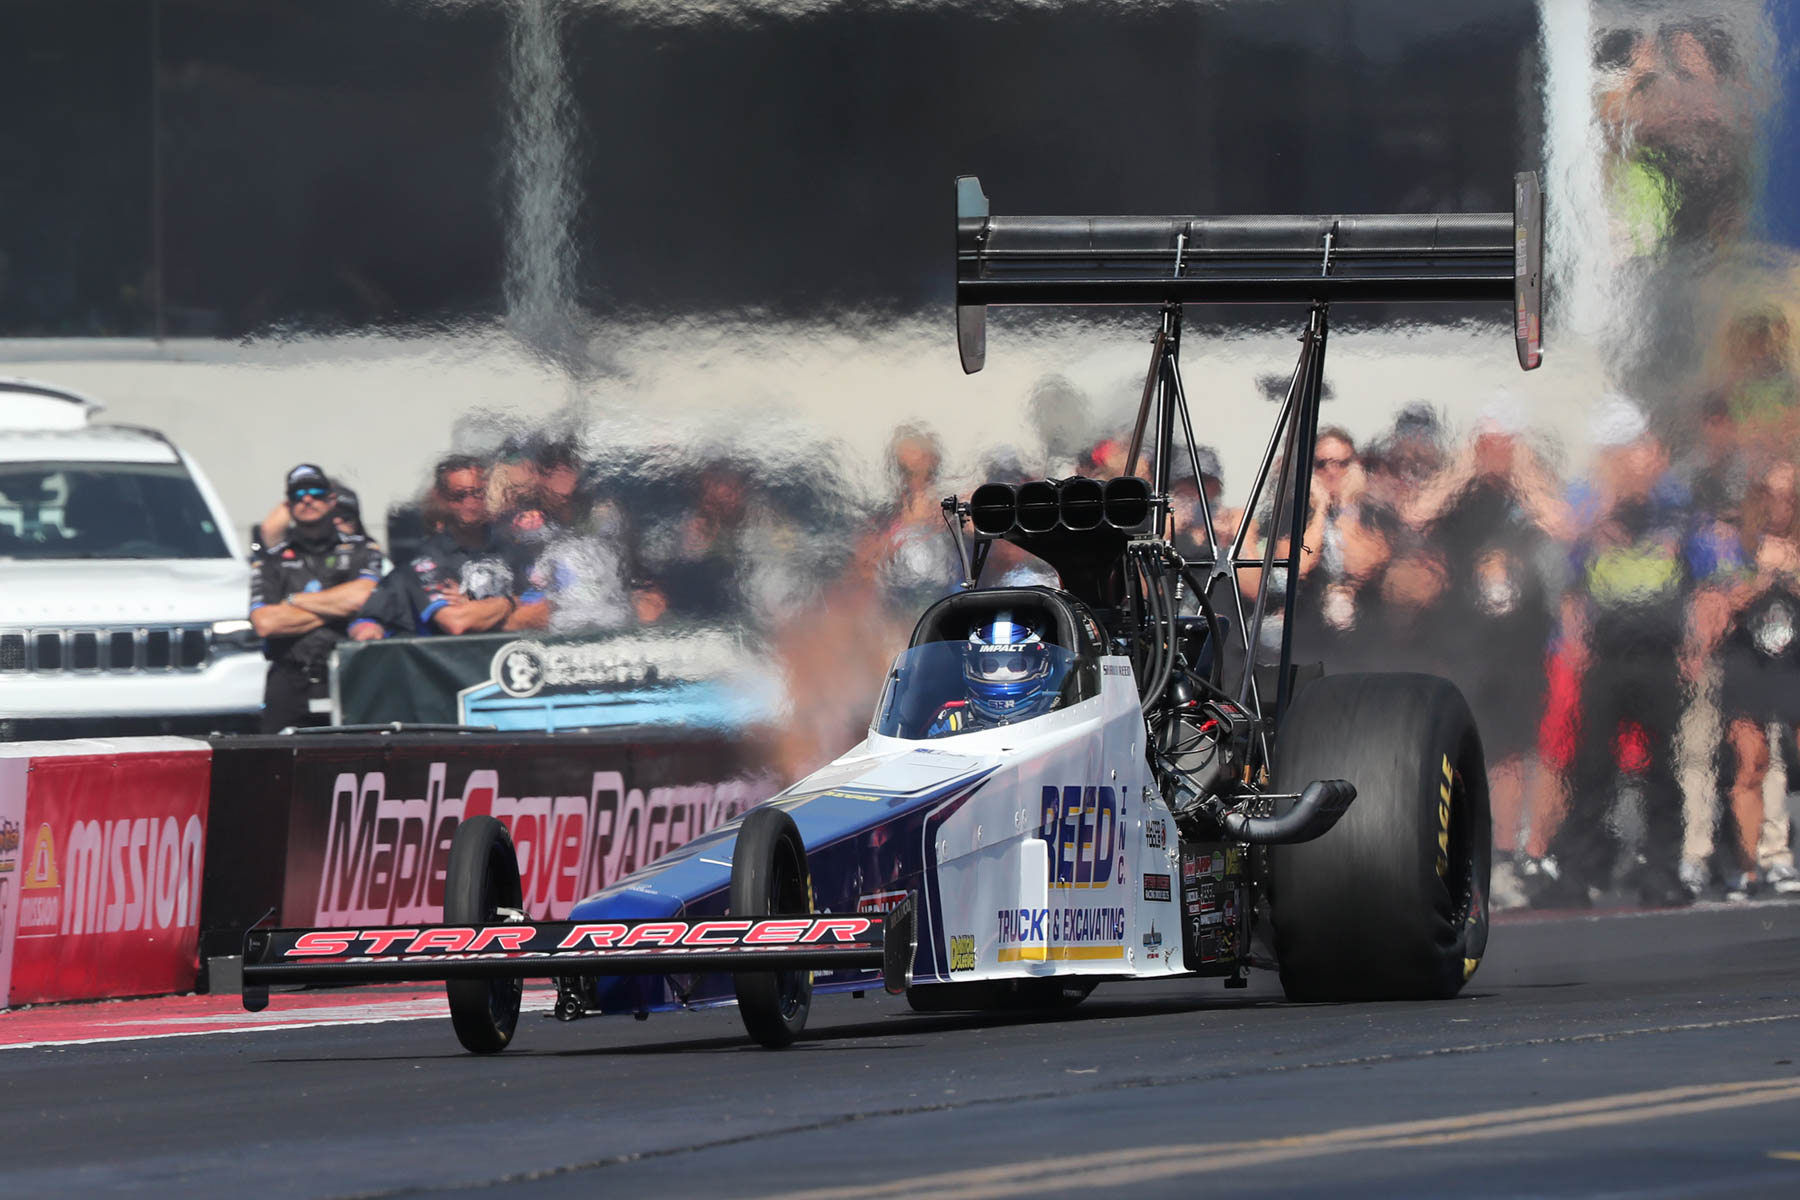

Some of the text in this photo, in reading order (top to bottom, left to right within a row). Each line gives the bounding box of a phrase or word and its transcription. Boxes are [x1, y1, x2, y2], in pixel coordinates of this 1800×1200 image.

[979, 643, 1027, 653] IMPACT
[1037, 785, 1117, 889] REED
[1436, 752, 1453, 877] EAGLE
[61, 814, 202, 936] MISSION
[284, 925, 538, 956] STAR
[556, 916, 871, 949] RACER
[1053, 908, 1060, 941] &
[1063, 907, 1125, 941] EXCAVATING
